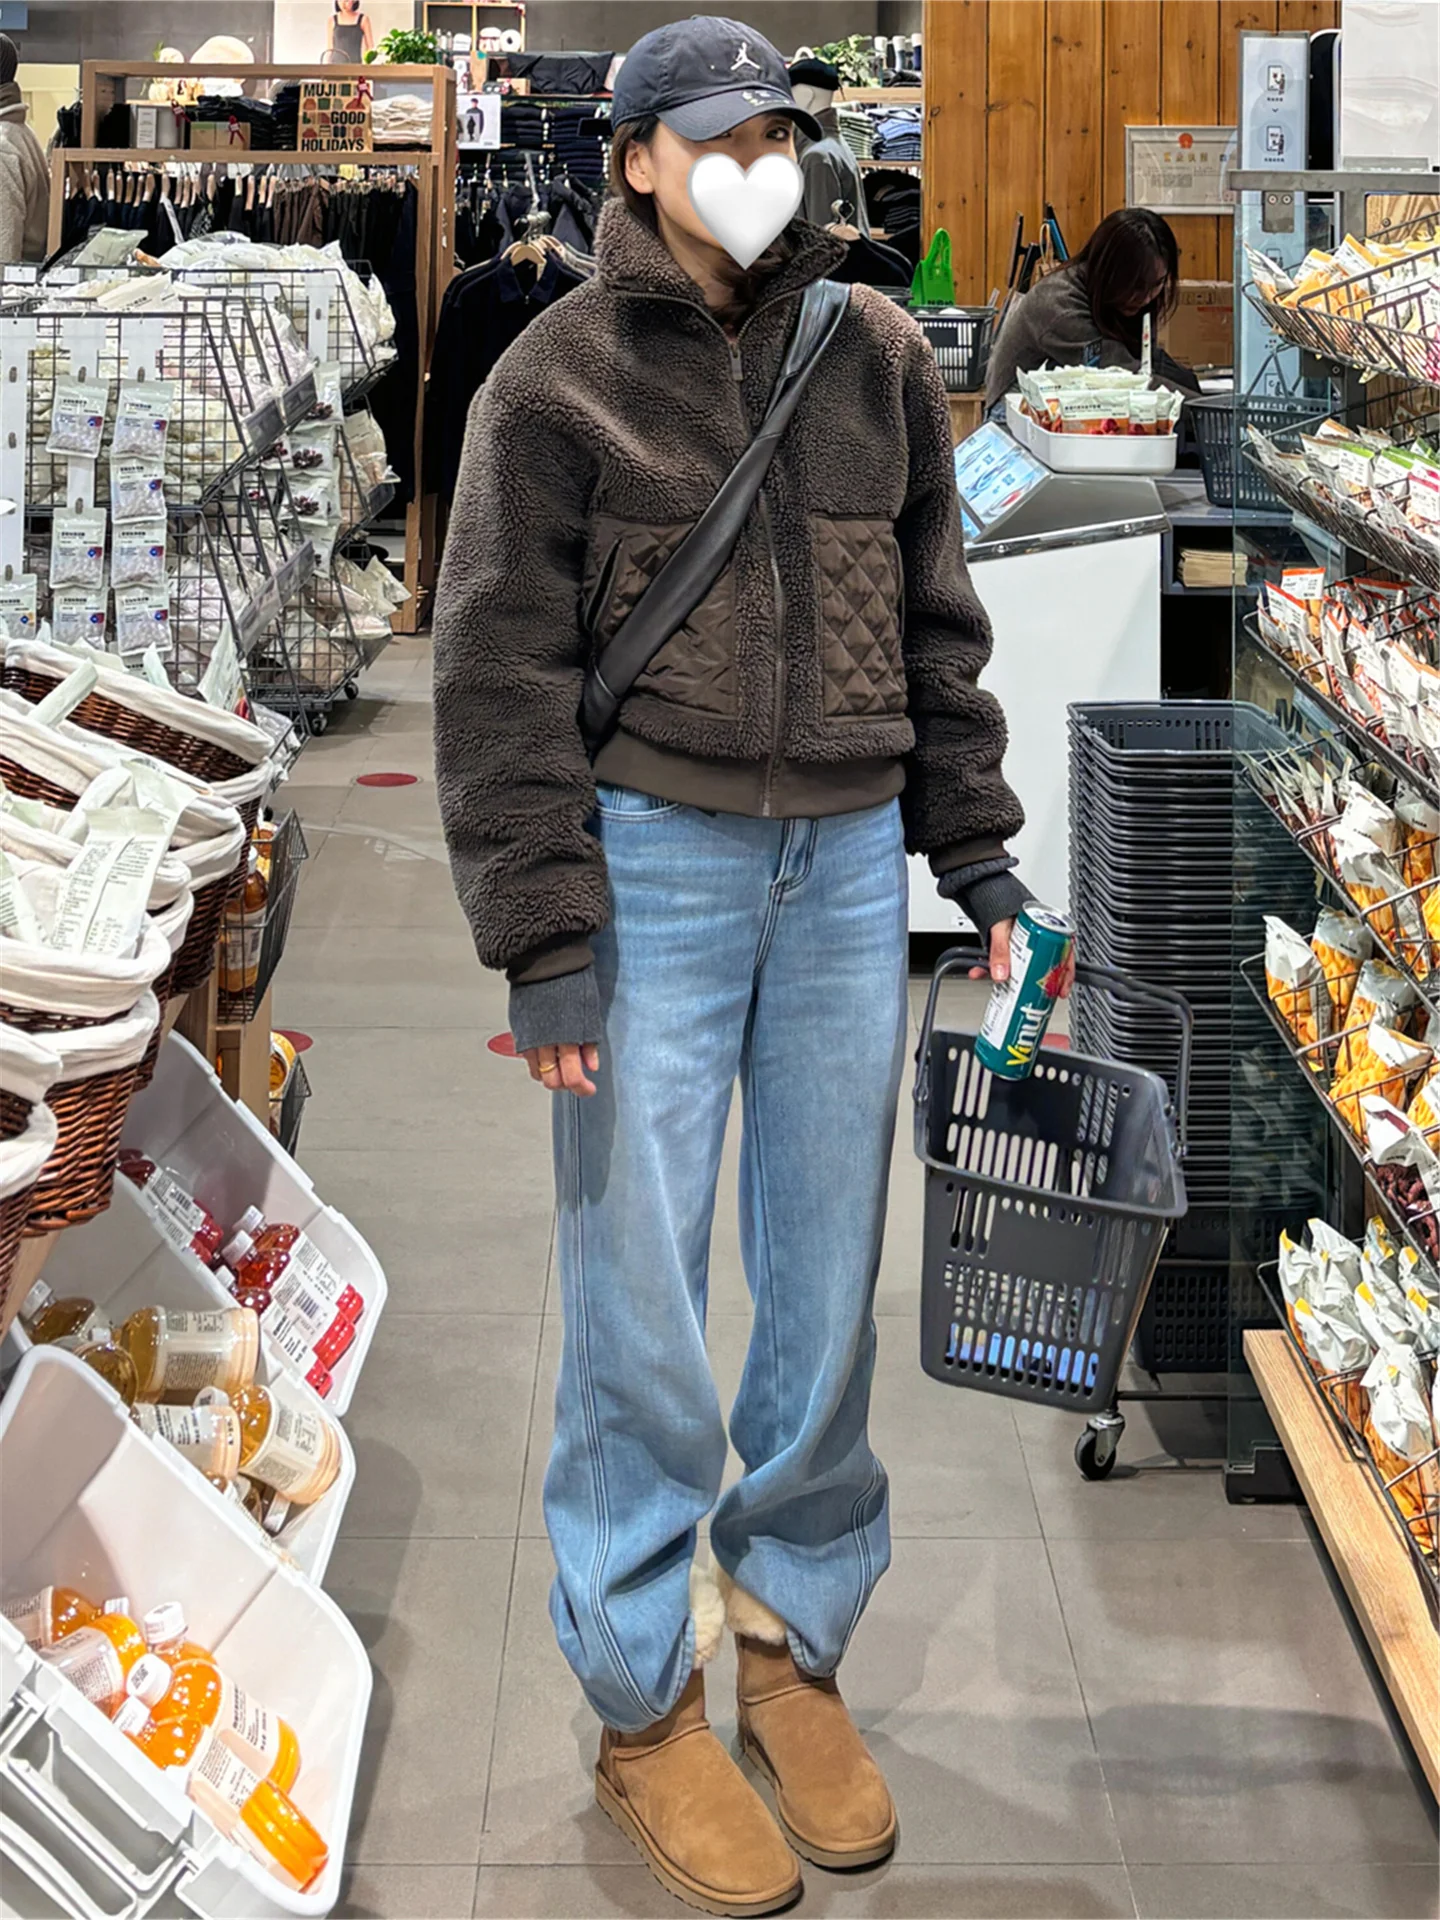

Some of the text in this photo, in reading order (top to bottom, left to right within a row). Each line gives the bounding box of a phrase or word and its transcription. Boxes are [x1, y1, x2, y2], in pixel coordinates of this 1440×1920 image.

[304, 83, 336, 97] MUJI
[331, 111, 366, 125] GOOD
[301, 138, 365, 152] HOLIDAYS
[1006, 1002, 1051, 1066] Vinut
